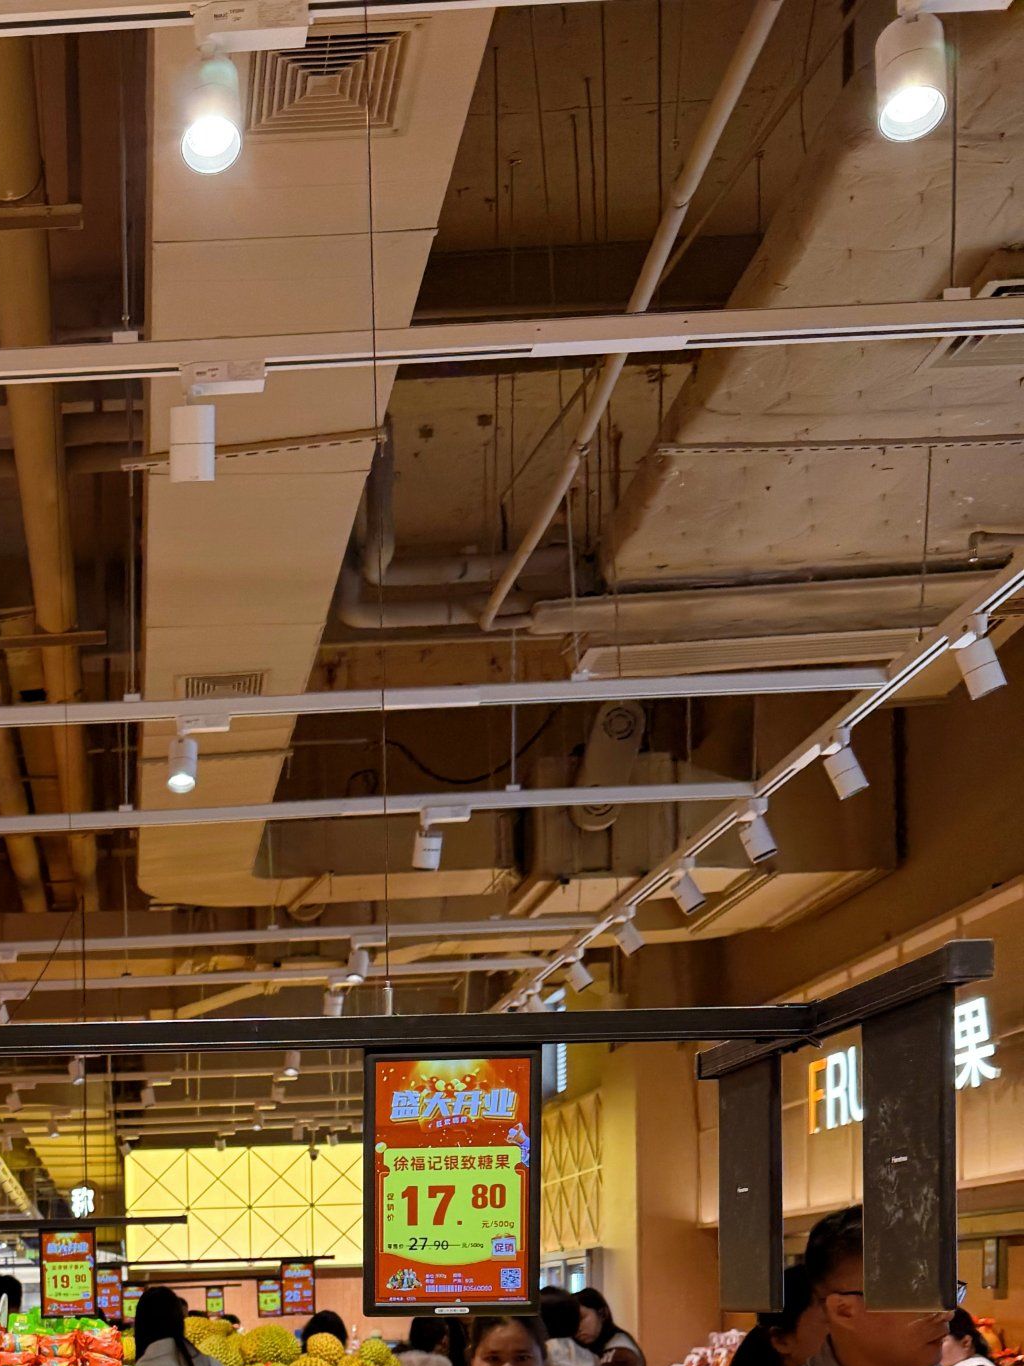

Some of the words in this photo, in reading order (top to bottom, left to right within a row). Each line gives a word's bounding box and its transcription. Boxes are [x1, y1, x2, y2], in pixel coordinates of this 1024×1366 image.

[954, 997, 1001, 1089] 果
[390, 1088, 516, 1120] 盛大开业
[393, 1154, 510, 1171] 徐福记银致糖果
